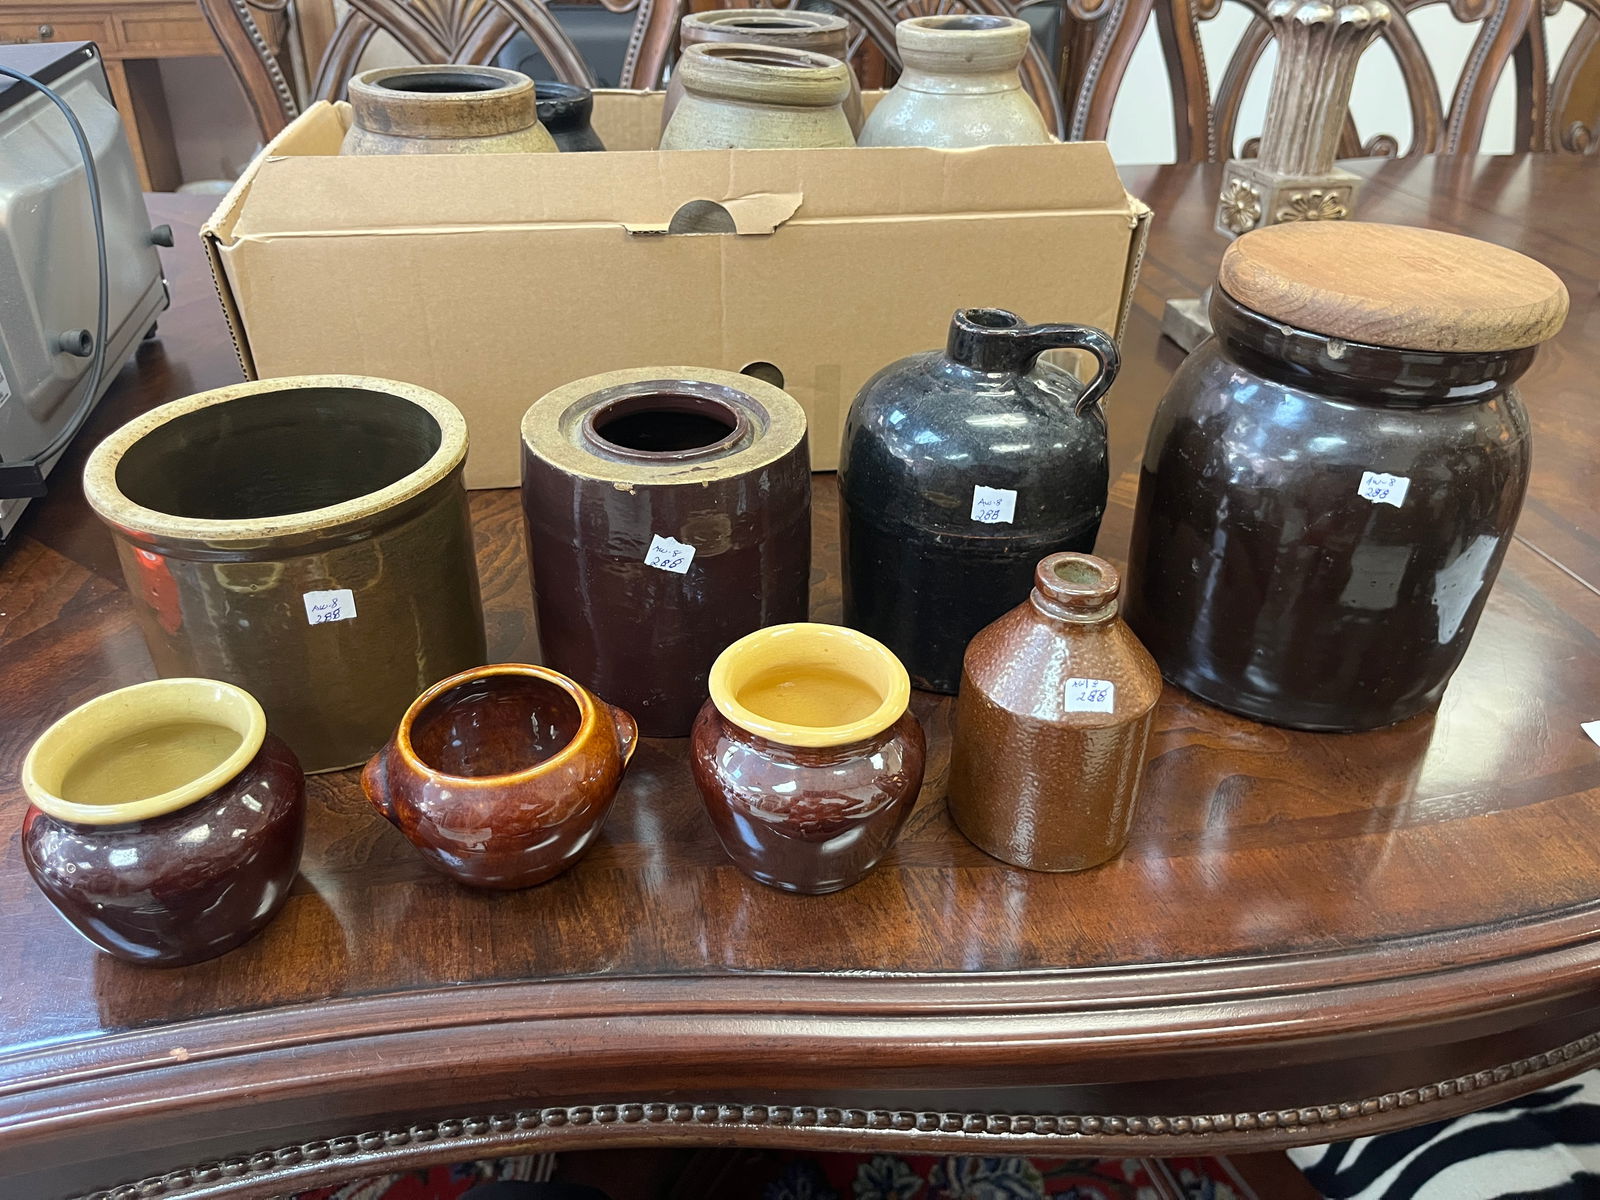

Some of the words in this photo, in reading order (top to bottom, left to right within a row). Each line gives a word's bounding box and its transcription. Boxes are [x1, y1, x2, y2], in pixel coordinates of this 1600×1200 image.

[975, 509, 1001, 521] 288
[315, 607, 342, 623] 288
[1076, 688, 1108, 702] 288
